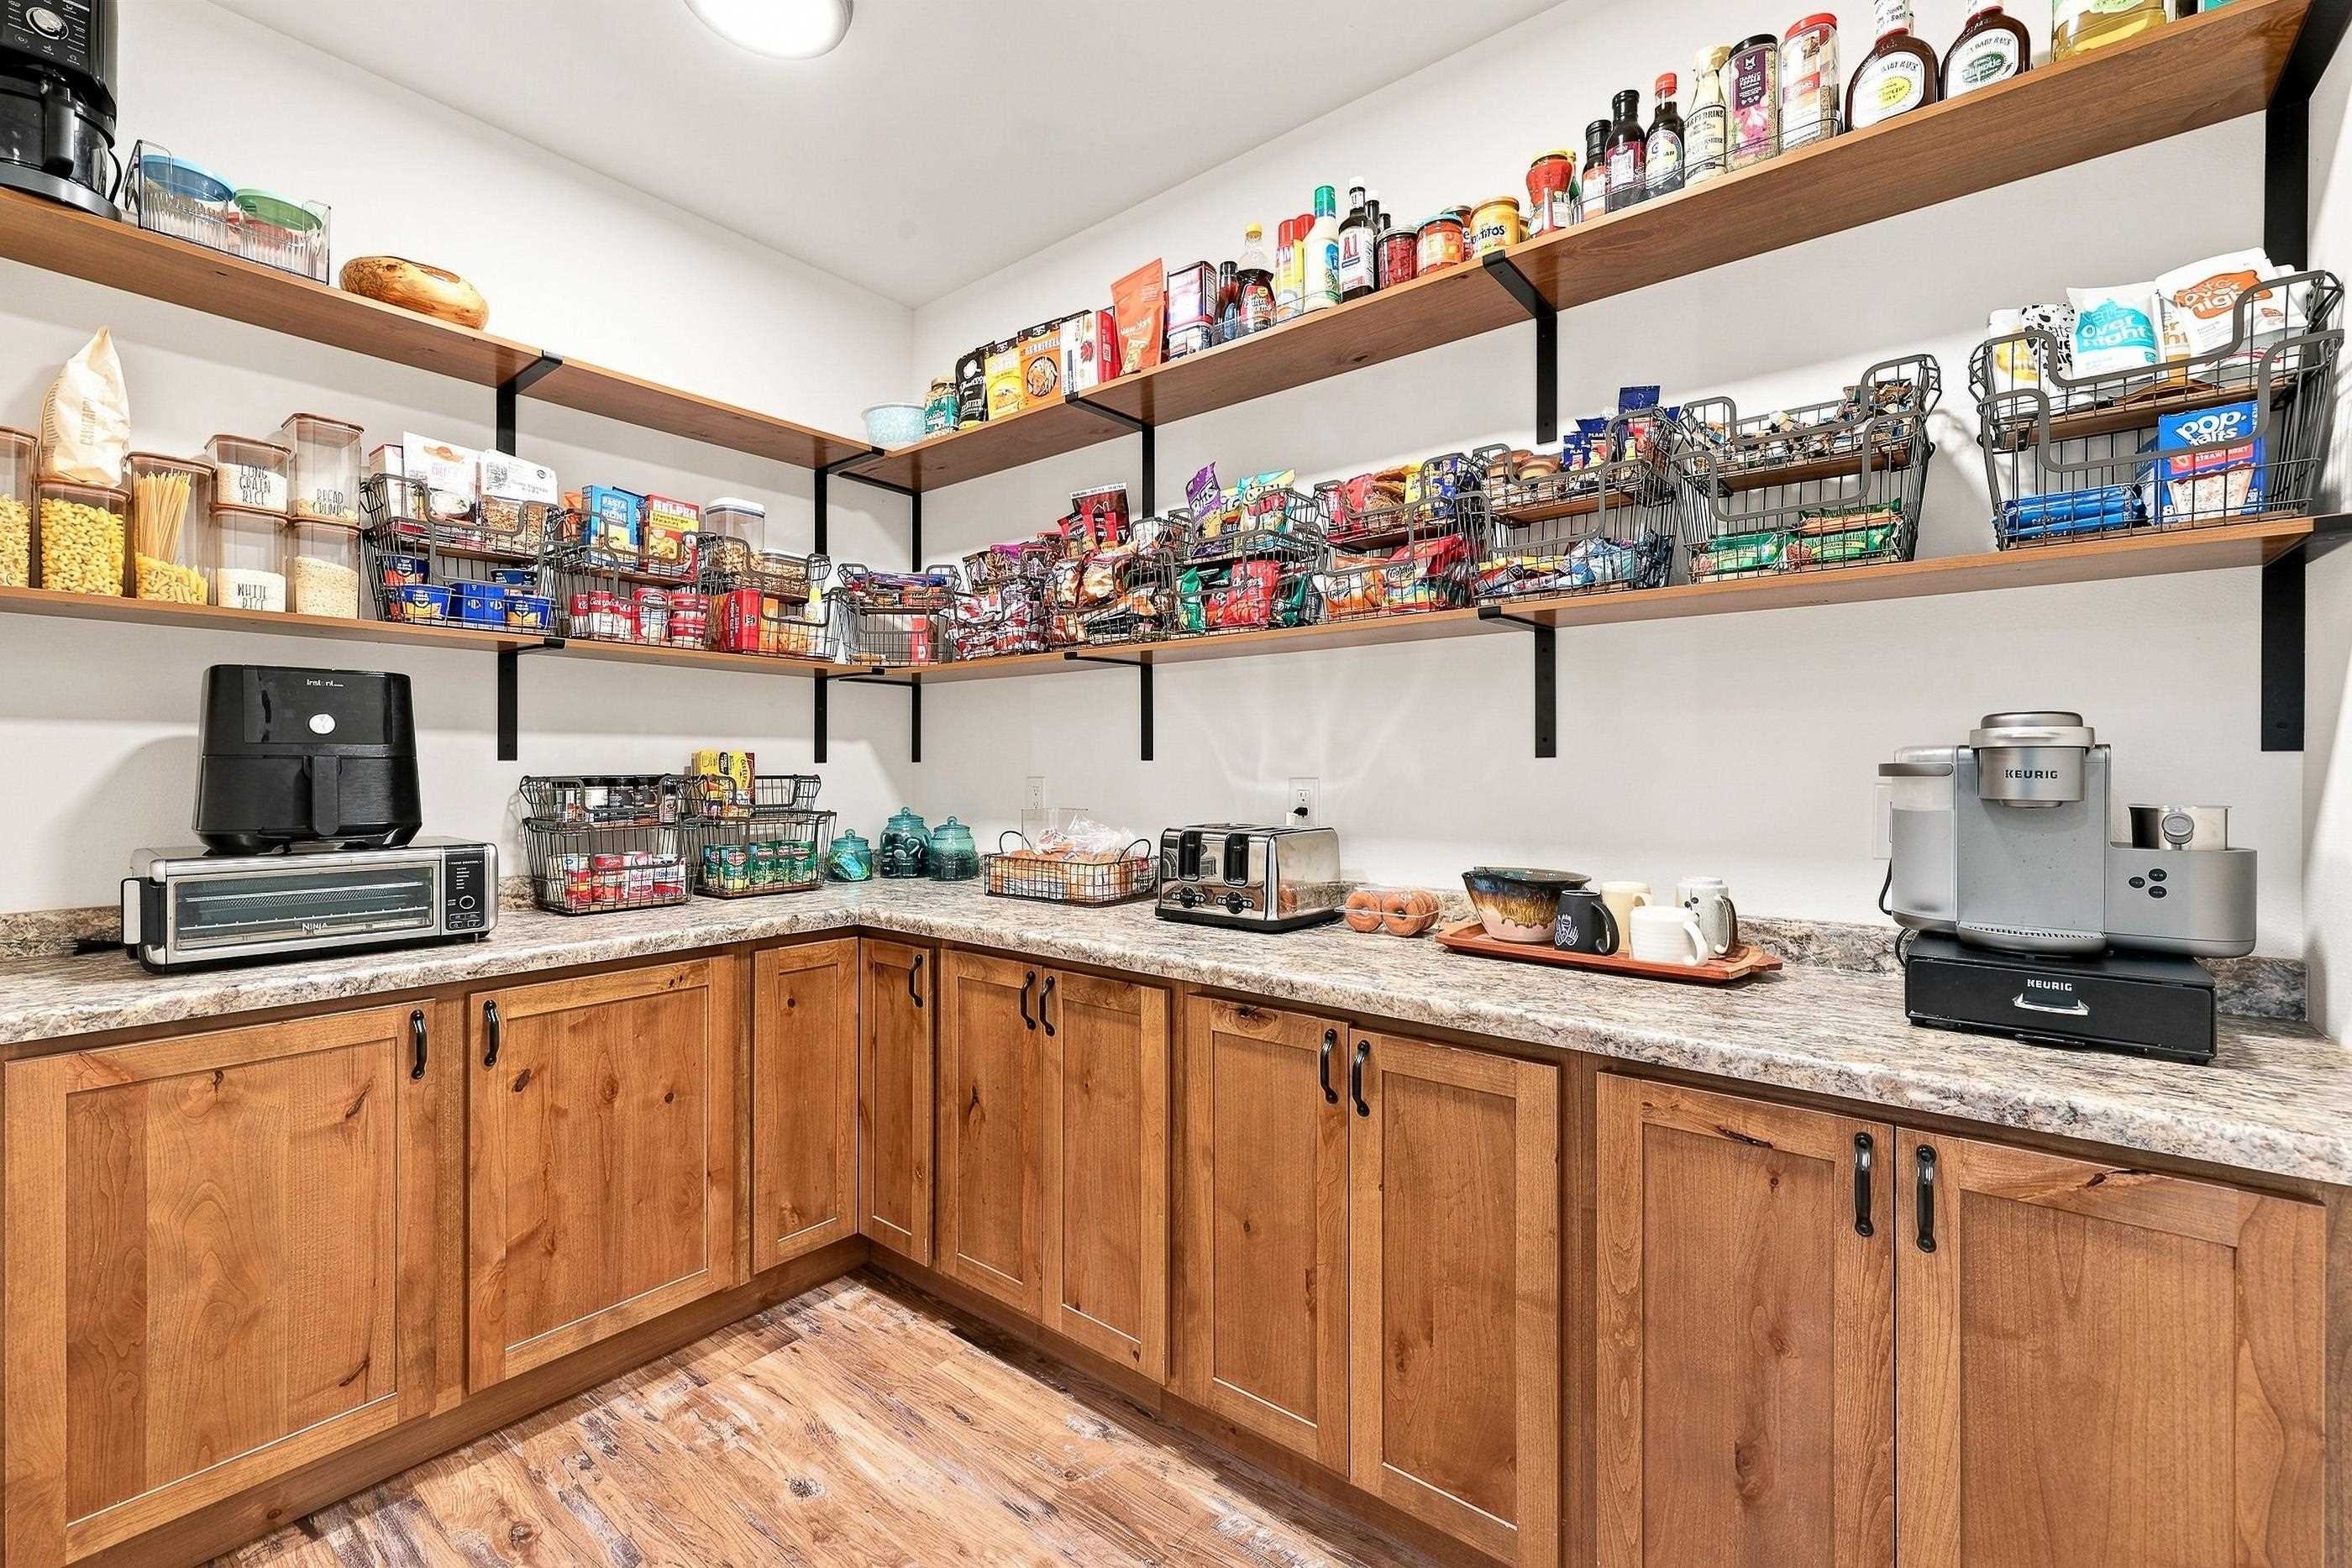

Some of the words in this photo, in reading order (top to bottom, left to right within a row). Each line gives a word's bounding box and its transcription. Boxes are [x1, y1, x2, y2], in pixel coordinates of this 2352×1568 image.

[241, 463, 268, 479] LONG
[239, 475, 270, 493] GRAIN
[242, 490, 265, 506] RICE
[317, 488, 343, 504] BREAD
[312, 501, 348, 518] CRUMBS
[653, 499, 697, 519] HELPER
[2005, 769, 2058, 779] KEURIG
[302, 922, 328, 931] NINJA
[2027, 978, 2072, 992] KEURIG
